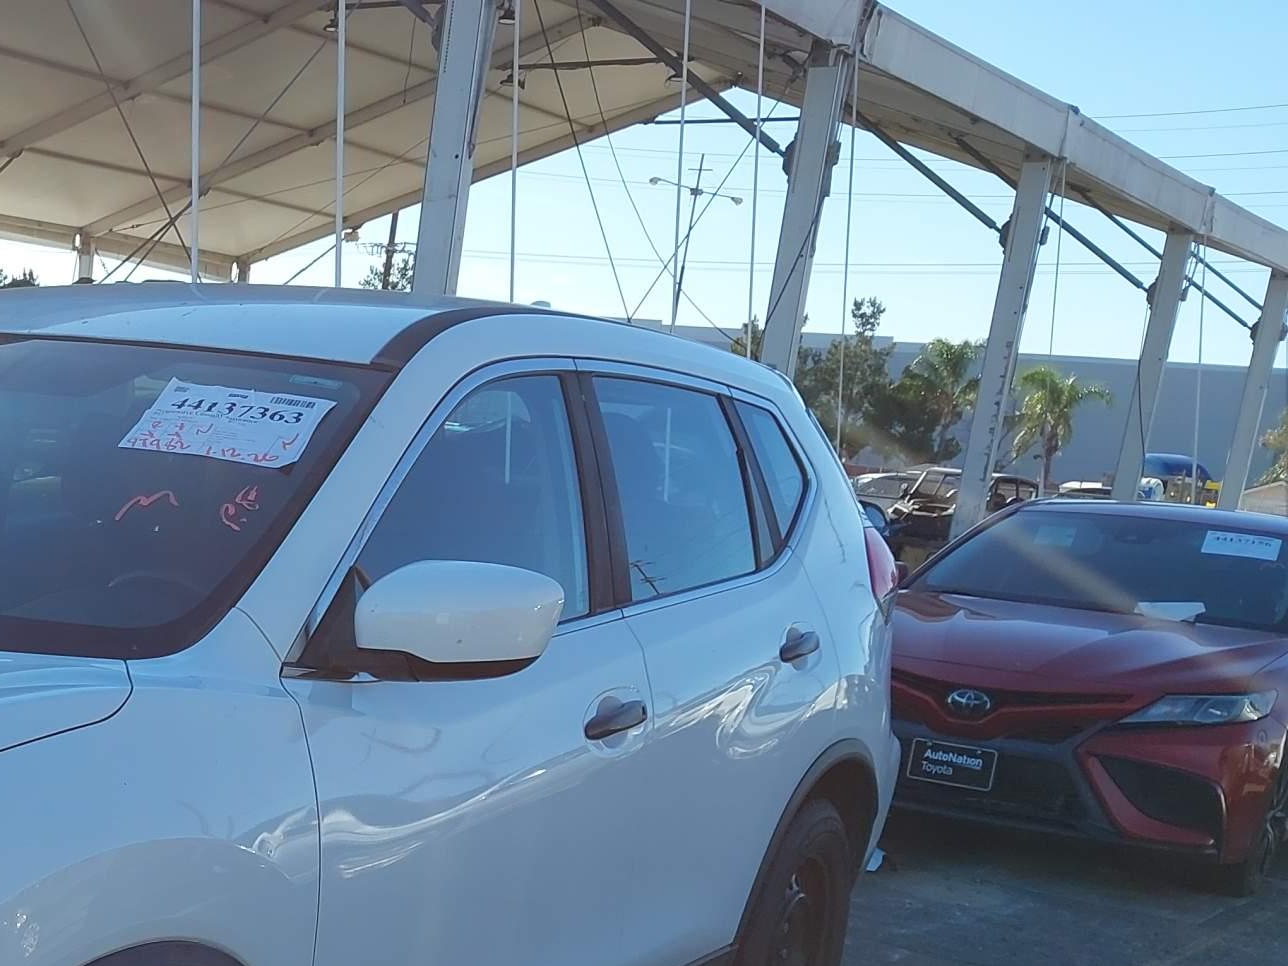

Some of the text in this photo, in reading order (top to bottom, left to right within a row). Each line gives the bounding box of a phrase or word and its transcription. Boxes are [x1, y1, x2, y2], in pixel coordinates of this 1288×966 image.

[171, 397, 304, 424] 44137363
[925, 749, 983, 767] AutoNation
[921, 761, 953, 775] Toyota
